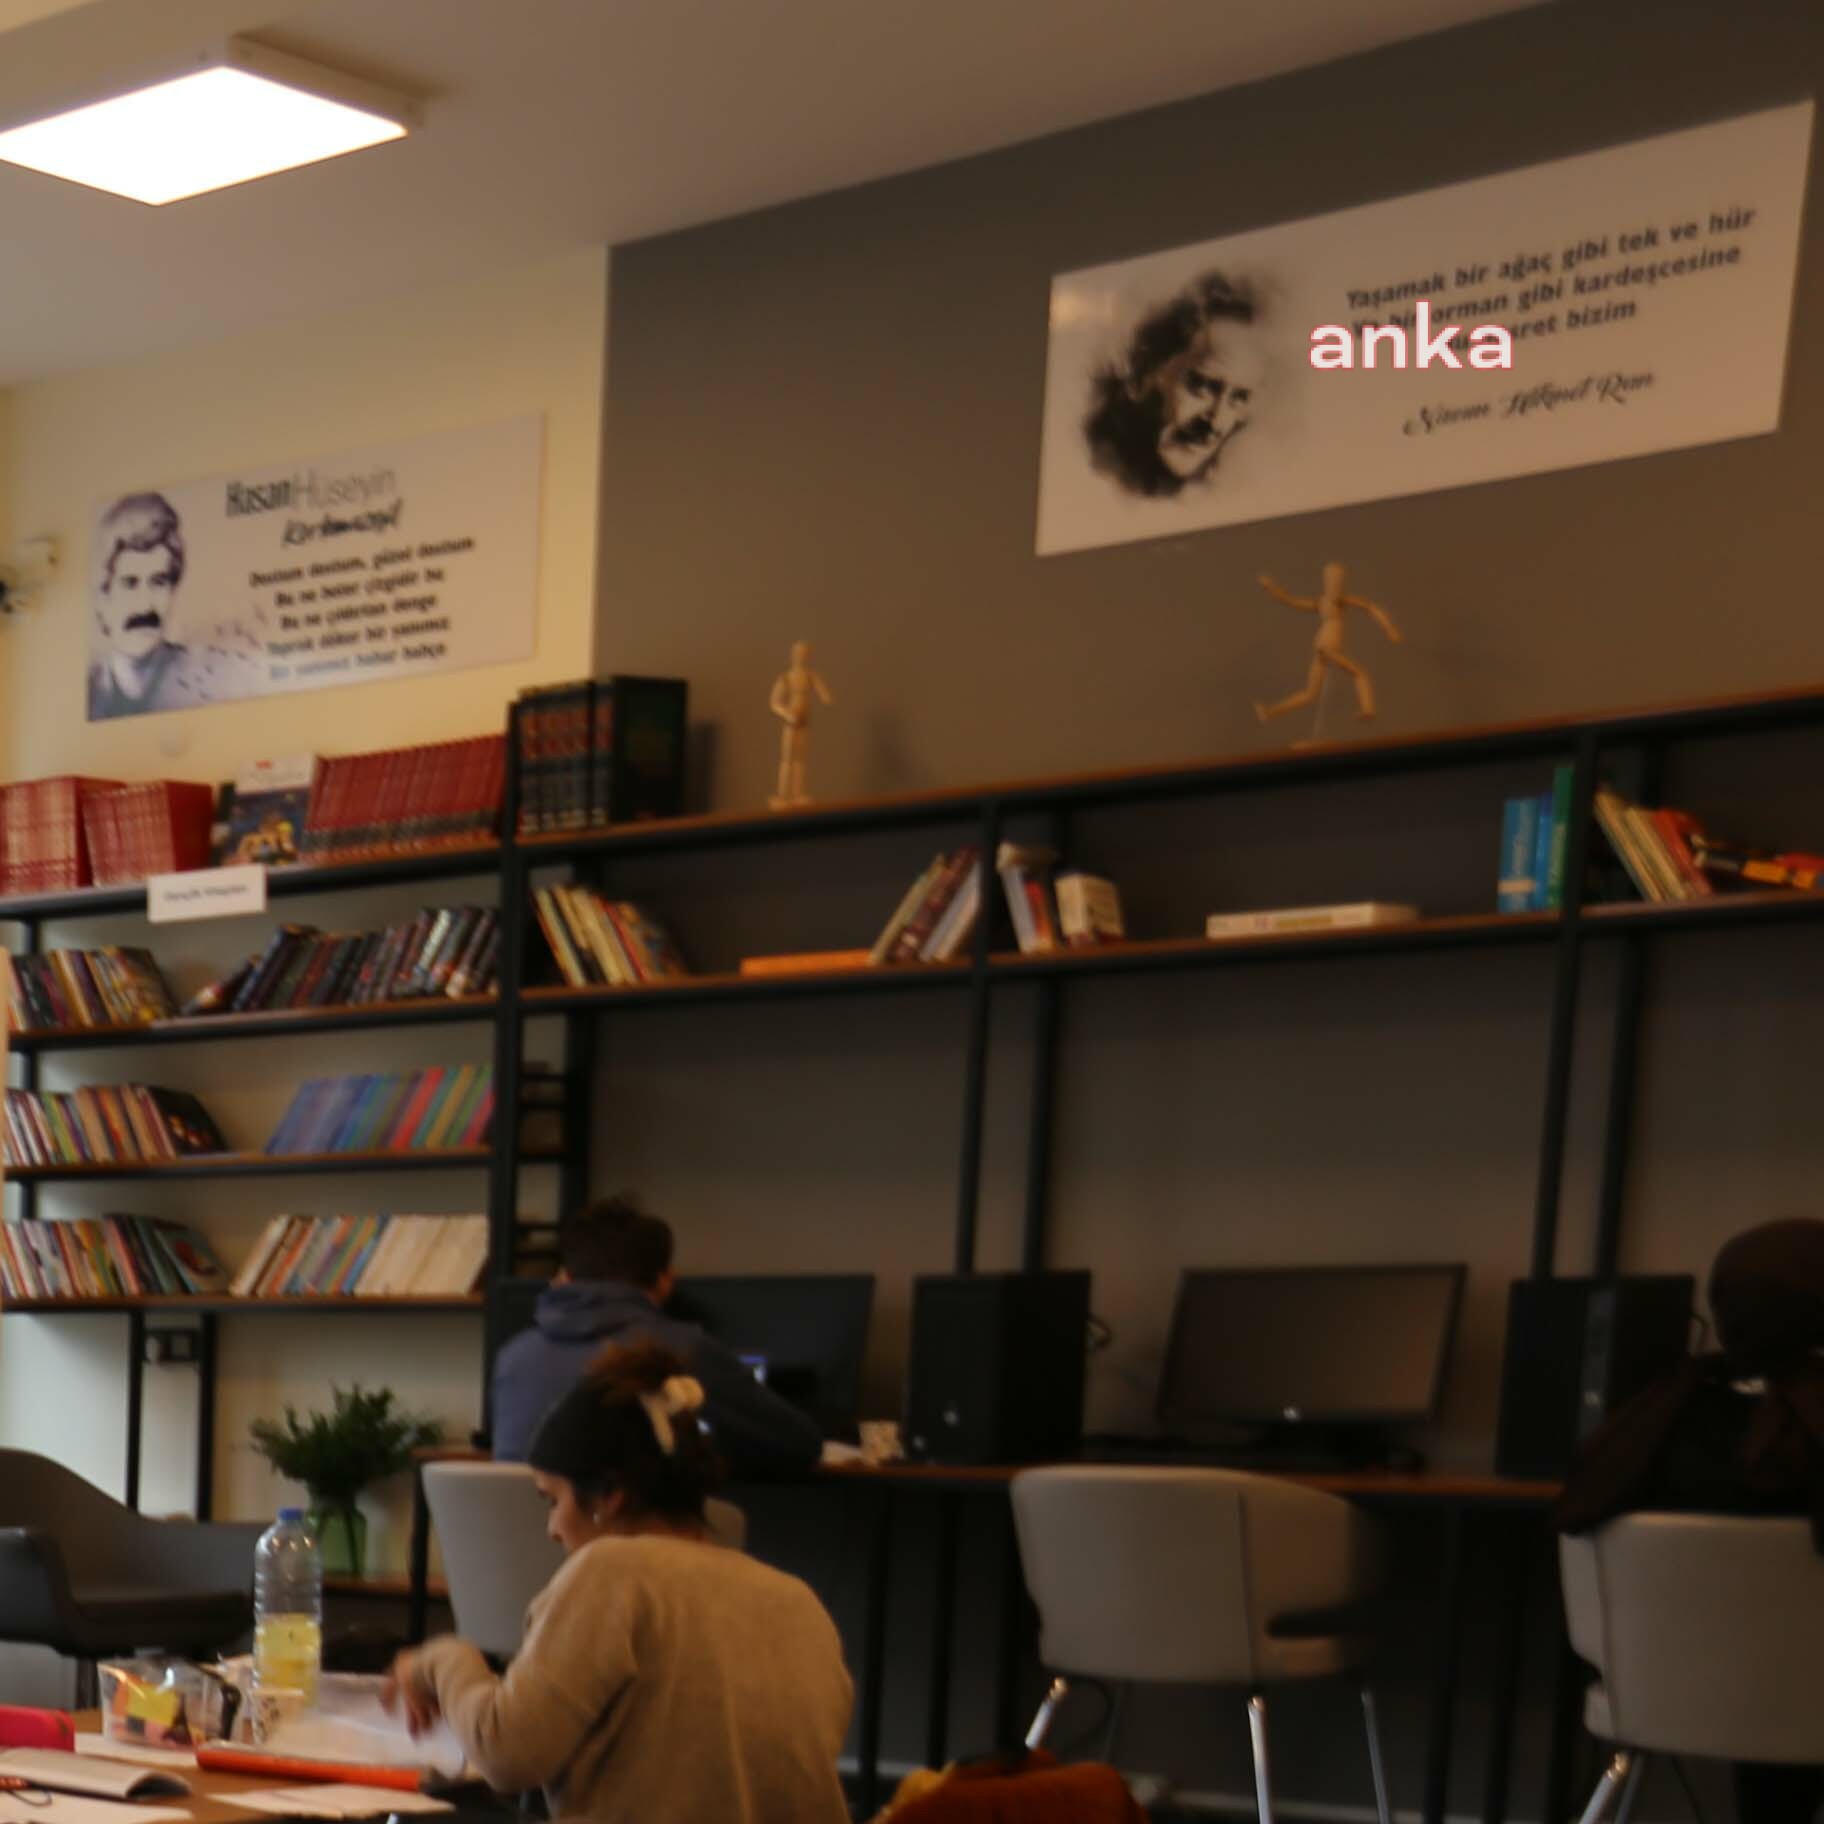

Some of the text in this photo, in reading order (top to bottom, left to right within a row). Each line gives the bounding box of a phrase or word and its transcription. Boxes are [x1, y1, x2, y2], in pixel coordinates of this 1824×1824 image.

[1346, 207, 1756, 310] Yaşamak bir ağaç gibi tek ve hür
[1431, 295, 1509, 324] orman
[1517, 278, 1563, 313] gibi
[1566, 299, 1637, 327] bizim
